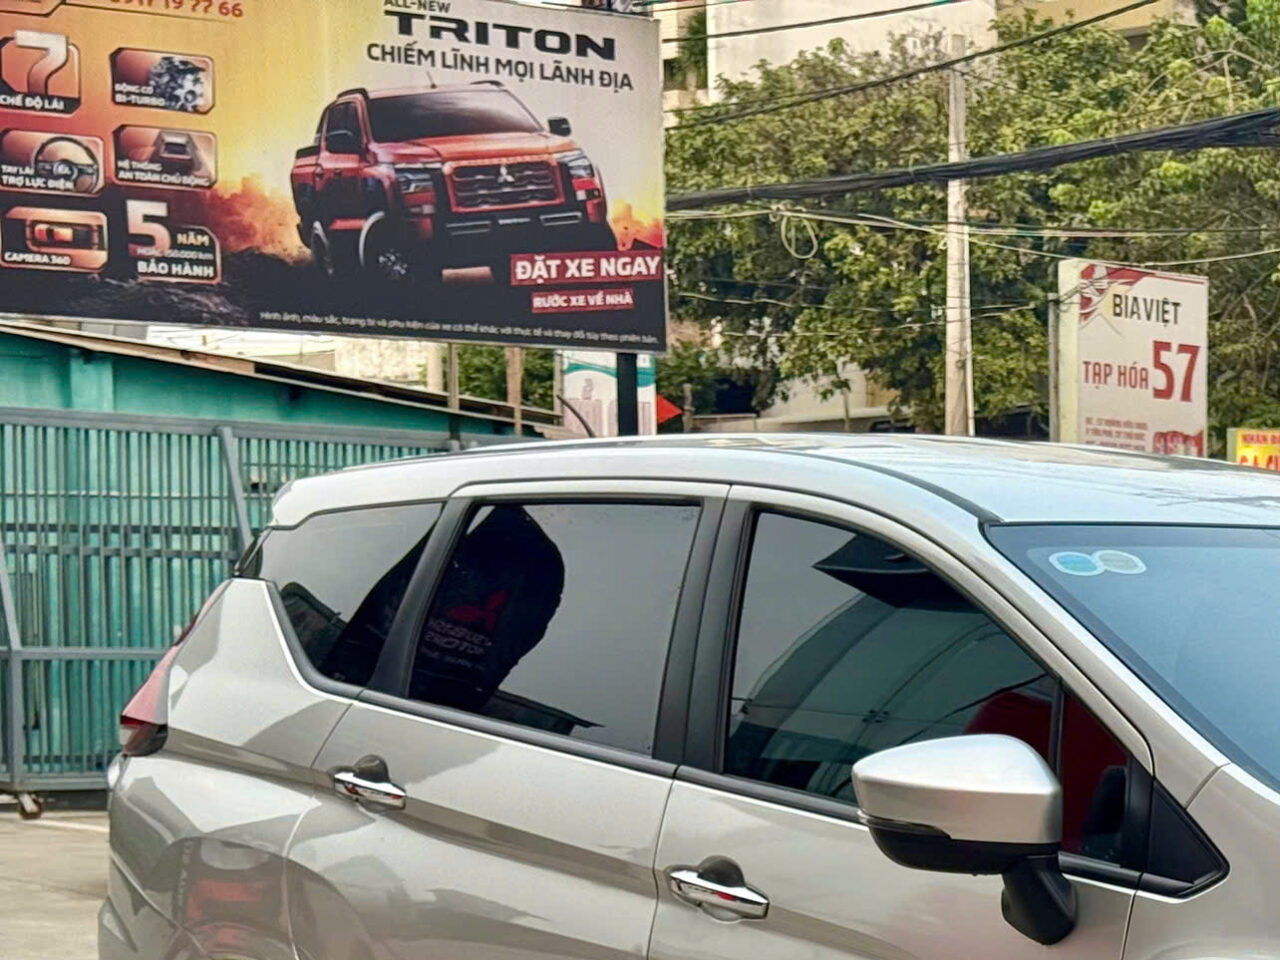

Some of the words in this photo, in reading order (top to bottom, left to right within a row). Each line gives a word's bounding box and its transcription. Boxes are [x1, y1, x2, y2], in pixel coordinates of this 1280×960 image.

[219, 2, 244, 17] 66
[384, 0, 451, 13] ALL-NEW
[384, 10, 616, 61] TRITON
[15, 29, 68, 96] 7
[367, 41, 435, 68] CHIẾM
[441, 48, 490, 75] LĨNH
[495, 58, 534, 83] MỌI
[539, 60, 594, 86] LÃNH
[599, 71, 634, 94] ĐỊA
[126, 199, 171, 252] 5
[177, 231, 210, 247] NĂM
[4, 252, 50, 264] CAMERA
[137, 258, 169, 275] BẢO
[171, 261, 214, 278] HÀNH
[515, 255, 561, 284] ĐẶT
[565, 258, 595, 278] XE
[600, 256, 661, 277] NGAY
[569, 295, 586, 307] XE
[606, 291, 633, 305] NHÀ
[1112, 293, 1140, 320] BIA
[1144, 296, 1181, 327] VIỆT
[1083, 361, 1113, 390] TẠP
[1117, 361, 1149, 390] HÓA
[1153, 340, 1200, 402] 57
